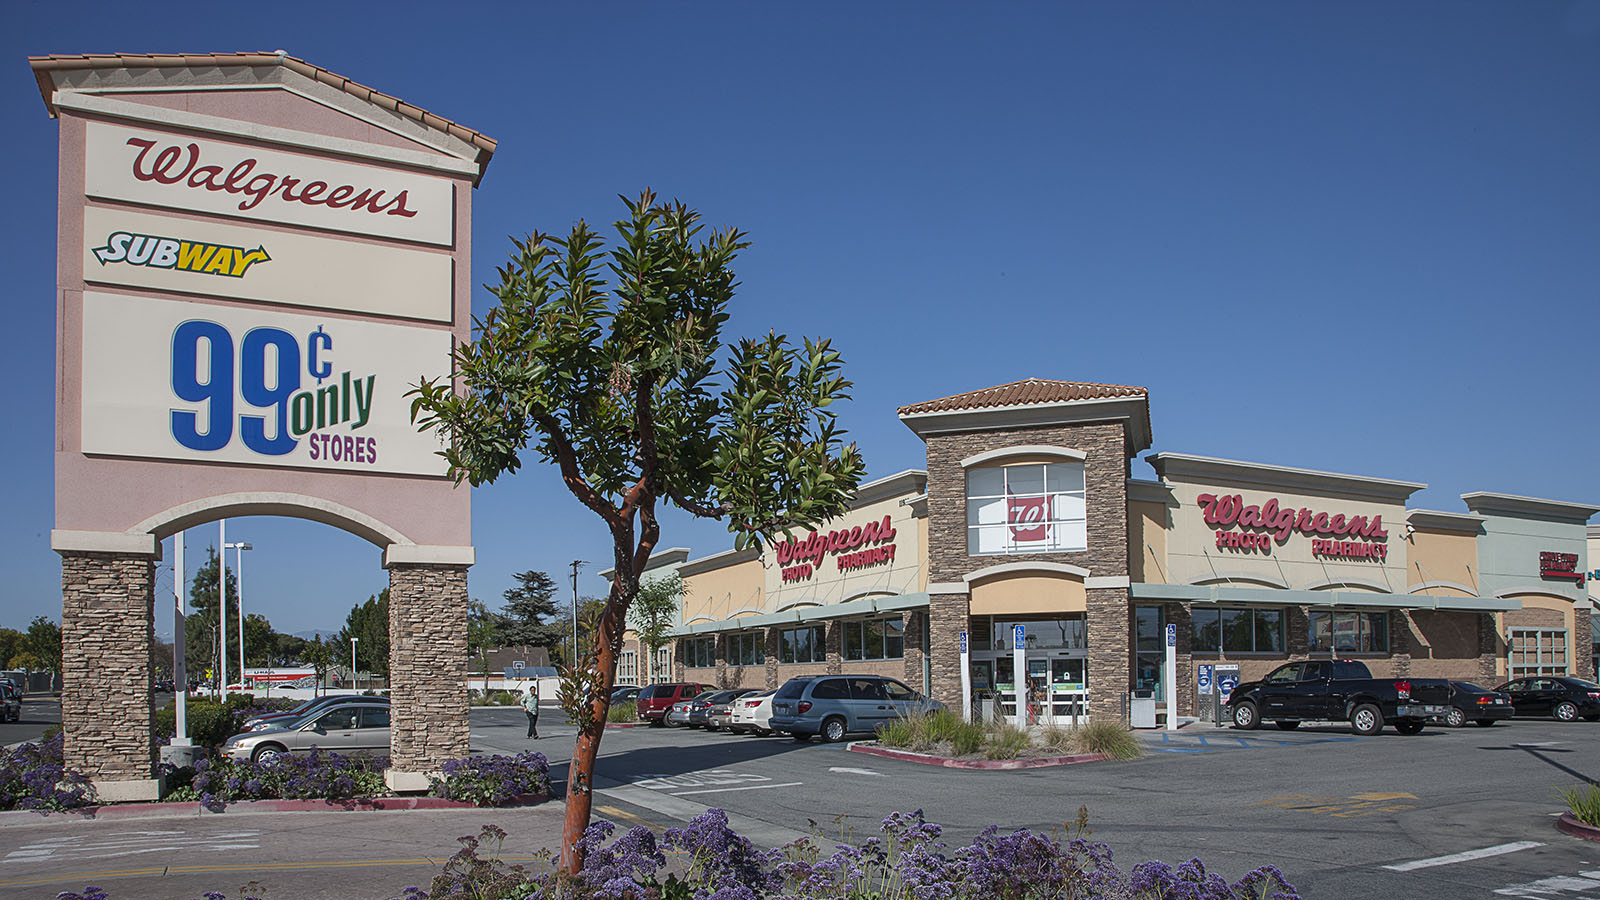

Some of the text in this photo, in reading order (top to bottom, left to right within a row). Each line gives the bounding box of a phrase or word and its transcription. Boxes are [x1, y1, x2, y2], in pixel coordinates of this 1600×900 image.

[126, 137, 418, 218] Walgreens
[92, 231, 272, 278] SUBWAY
[291, 371, 376, 436] only
[309, 433, 377, 464] STORES
[774, 515, 897, 567] Walgreens
[1197, 493, 1388, 542] Walgreens
[837, 544, 896, 570] PHARMACY
[1216, 531, 1388, 559] PHOTO PHARMACY
[782, 563, 813, 581] PHOTO
